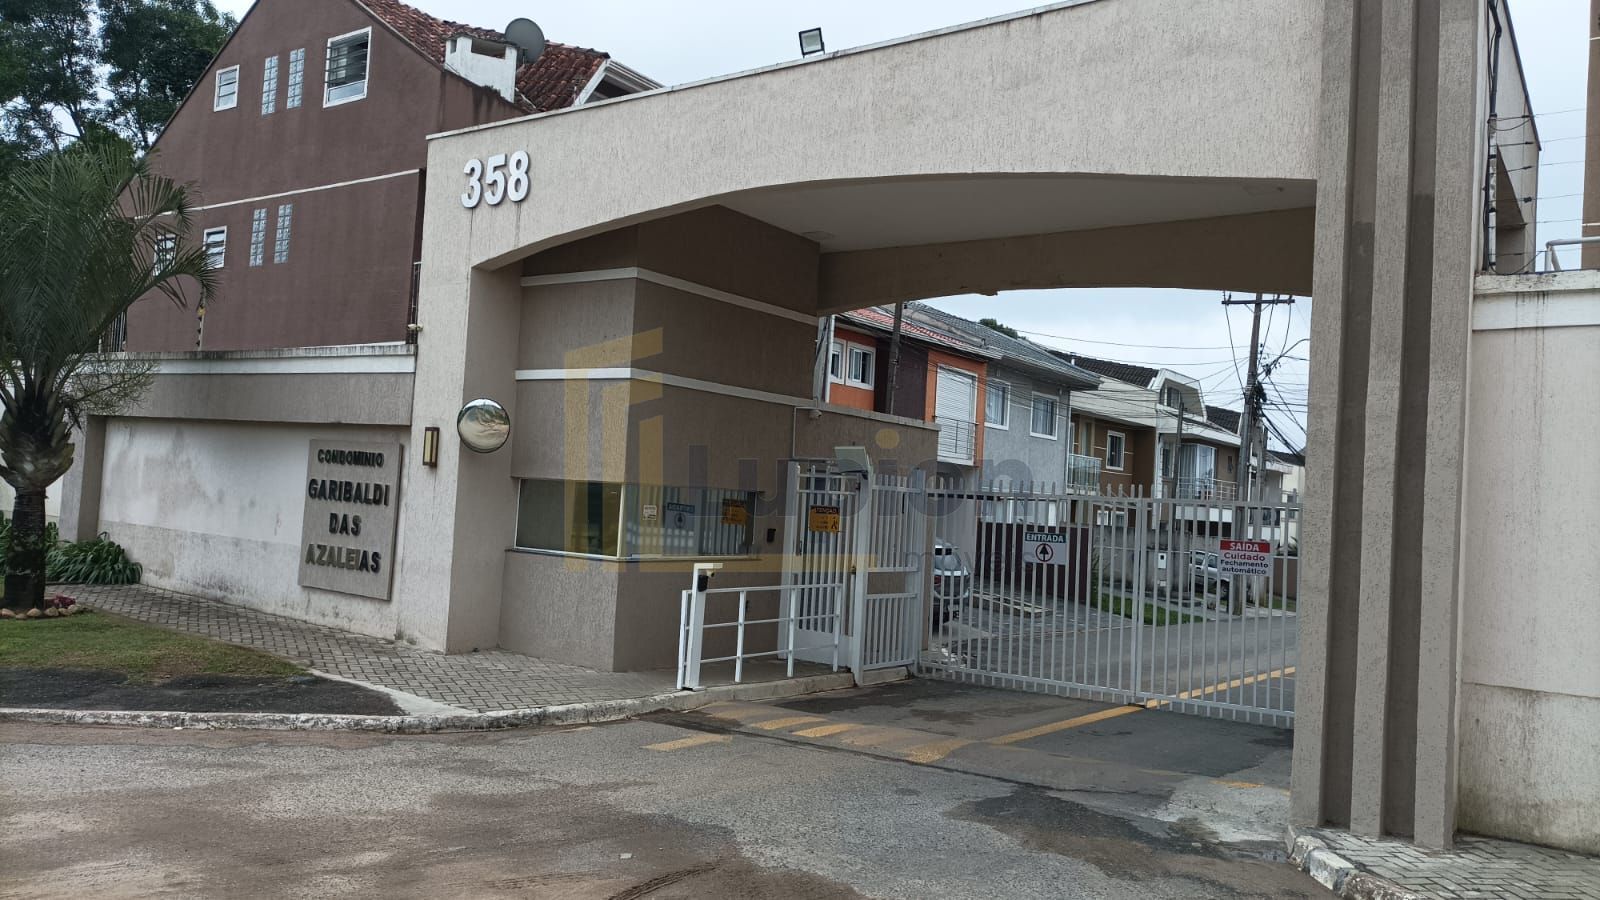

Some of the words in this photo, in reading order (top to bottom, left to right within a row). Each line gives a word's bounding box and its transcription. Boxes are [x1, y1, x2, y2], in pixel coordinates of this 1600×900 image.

[461, 151, 530, 208] 358
[318, 449, 384, 468] CONDOMINIO
[308, 478, 390, 506] GARIBALDI
[329, 513, 362, 536] DAS
[1026, 533, 1064, 543] ENTRADA
[305, 544, 381, 574] AZALEIAS
[1221, 560, 1269, 568] Fechamento
[1224, 552, 1266, 561] Cuidado
[1222, 566, 1267, 575] automático
